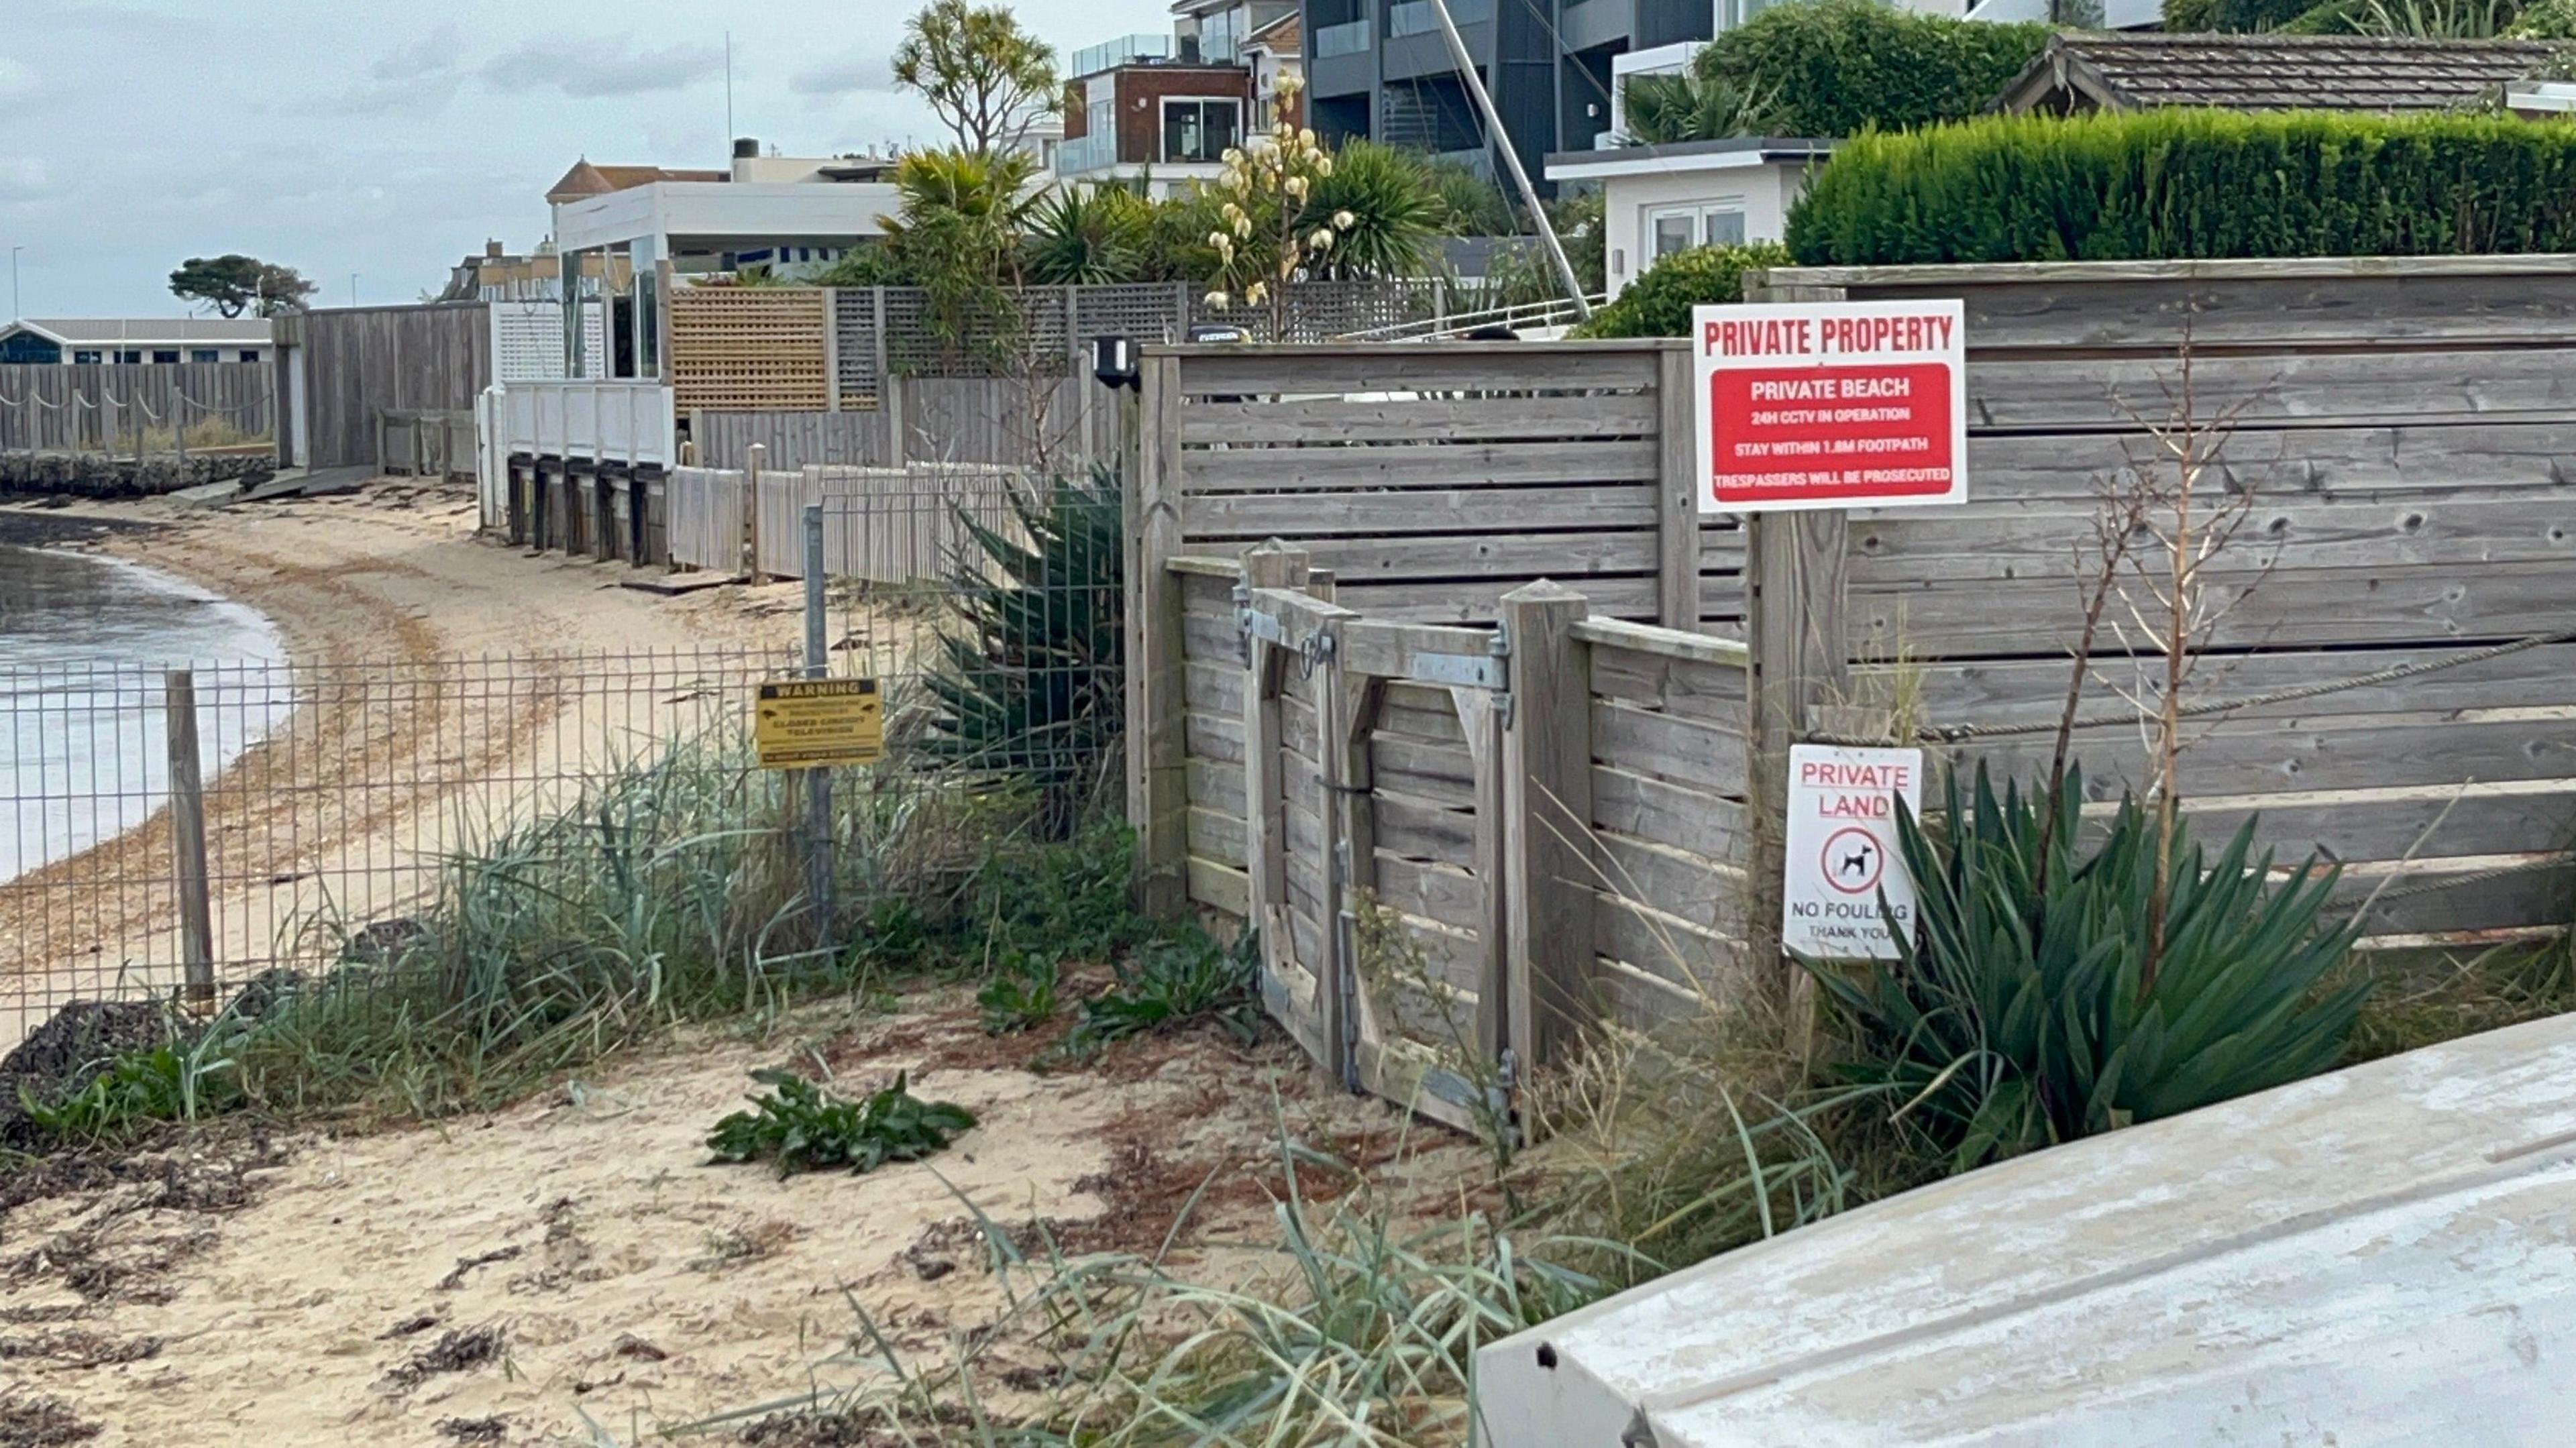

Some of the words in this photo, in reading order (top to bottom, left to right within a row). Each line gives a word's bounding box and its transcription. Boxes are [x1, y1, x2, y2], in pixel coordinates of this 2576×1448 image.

[1705, 320, 1811, 356] PRIVATE
[1821, 316, 1953, 353] PROPERTY
[1751, 380, 1837, 401] PRIVATE
[1841, 378, 1910, 398] BEACH
[1751, 411, 1778, 425] 24H
[1780, 410, 1815, 424] CCTV
[1817, 409, 1832, 423] IN
[1834, 407, 1911, 422] OPERATION
[1735, 441, 1769, 457] STAY
[1772, 439, 1820, 457] WITHIN
[1857, 437, 1929, 453] FOOTPATH
[1714, 472, 1807, 488] TRESPASSERS
[1809, 471, 1841, 486] WILL
[1843, 470, 1861, 484] BE
[1864, 467, 1950, 483] PROSECUTED
[777, 681, 860, 696] WARNING
[1801, 763, 1909, 787] PRIVATE
[1819, 795, 1890, 817] LAND
[1792, 902, 1819, 917] NO
[1825, 903, 1908, 920] FOULIG
[1811, 926, 1856, 938] THANK
[1861, 927, 1892, 939] YOU
